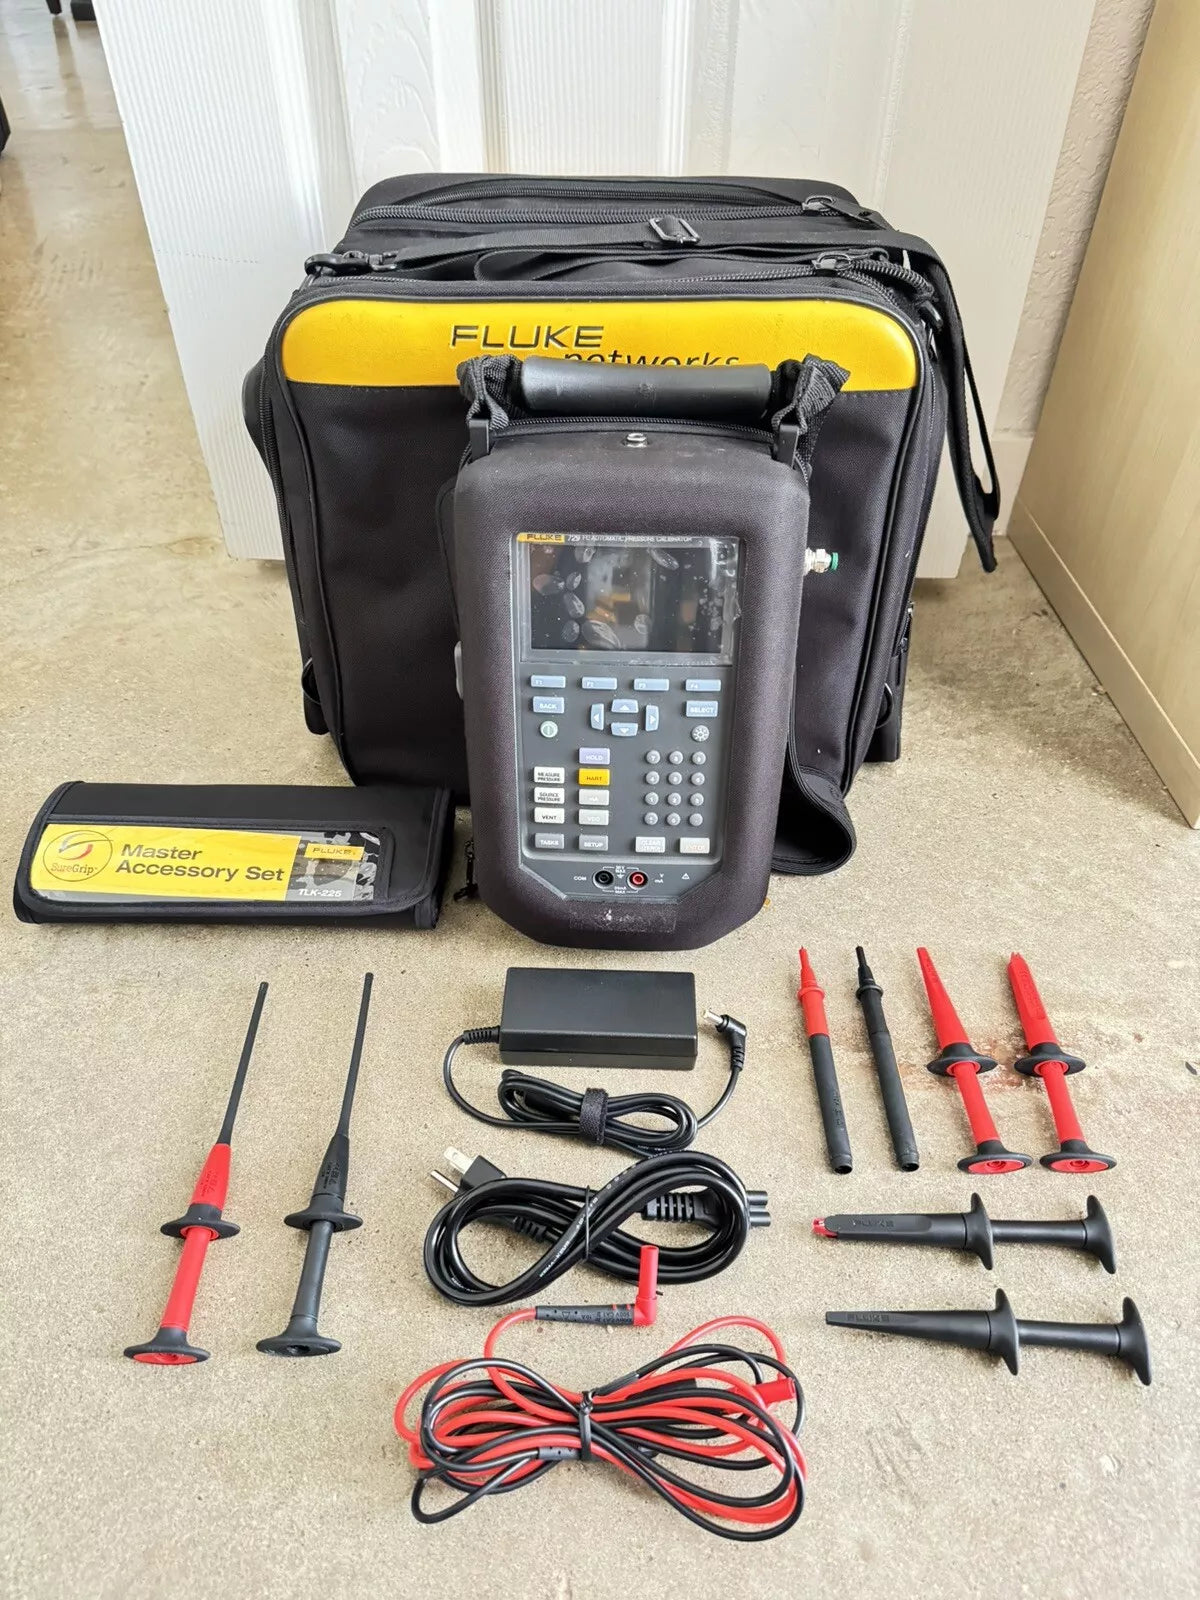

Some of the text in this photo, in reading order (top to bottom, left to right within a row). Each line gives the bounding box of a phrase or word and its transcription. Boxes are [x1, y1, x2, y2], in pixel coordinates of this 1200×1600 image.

[450, 324, 605, 348] FLUKE
[526, 533, 562, 541] FLUKE
[567, 534, 581, 542] 729
[121, 844, 203, 860] Master
[312, 847, 352, 855] FLUKE
[50, 862, 94, 876] SureGrip
[115, 860, 285, 882] Accessory Set
[299, 888, 343, 898] TLK-225
